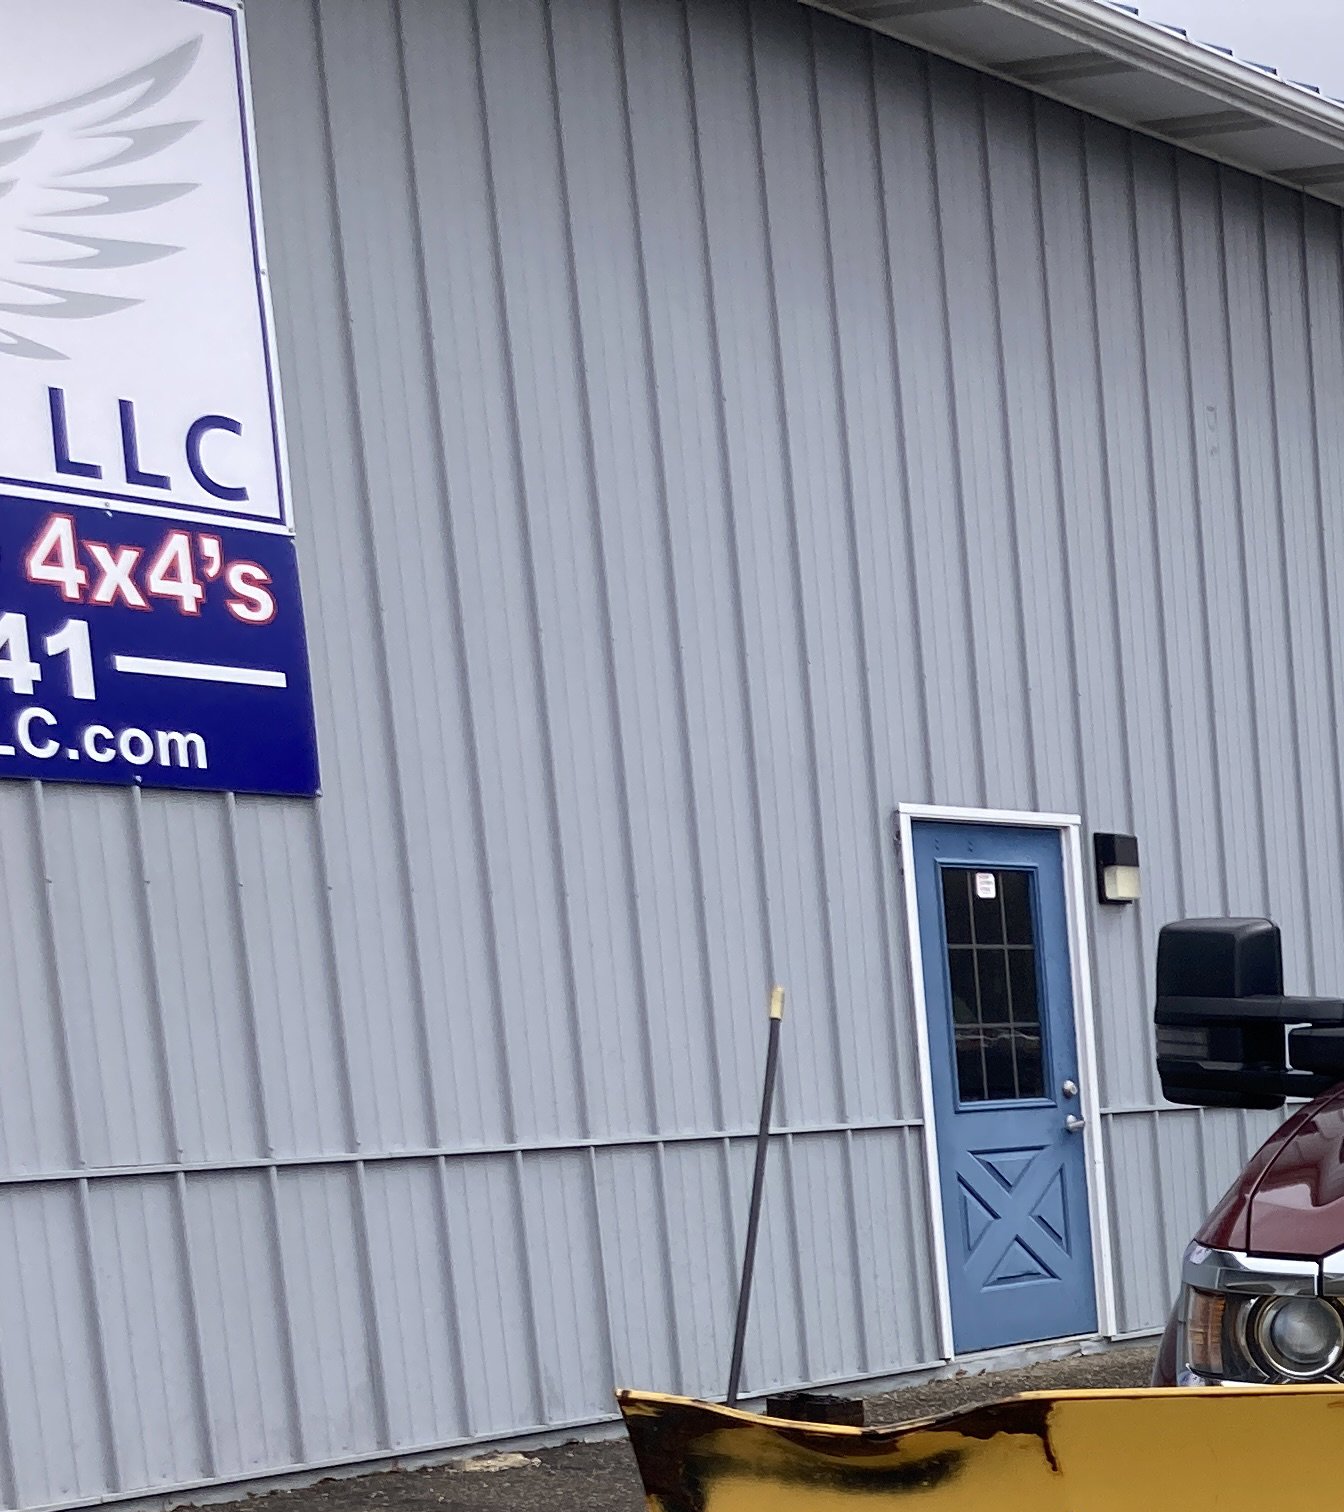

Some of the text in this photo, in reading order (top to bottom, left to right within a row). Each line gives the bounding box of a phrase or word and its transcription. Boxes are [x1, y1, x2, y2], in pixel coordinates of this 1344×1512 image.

[48, 386, 249, 501] LLC
[26, 513, 277, 625] 4x4's
[0, 612, 96, 700] 41
[0, 706, 208, 769] C.com
